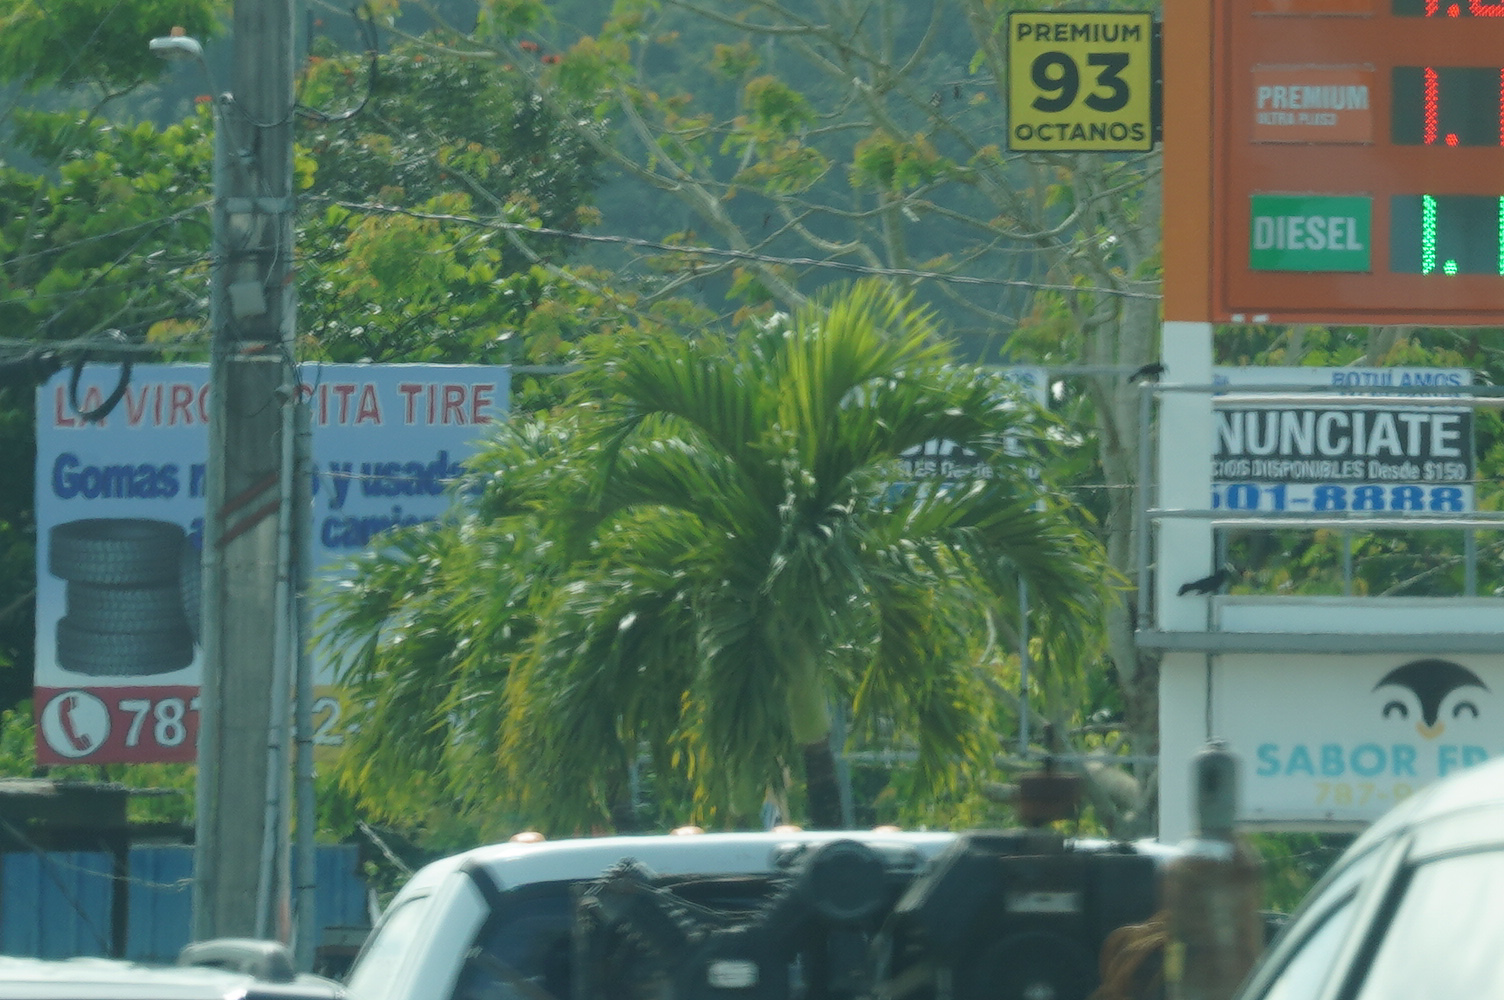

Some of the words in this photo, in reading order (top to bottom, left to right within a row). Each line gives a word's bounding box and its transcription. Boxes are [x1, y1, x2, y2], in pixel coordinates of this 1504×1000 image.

[1016, 23, 1141, 42] PREMIUM
[1030, 51, 1130, 113] 93
[1257, 85, 1369, 110] PREMIUM
[1015, 122, 1145, 142] OCTANOS
[1253, 216, 1363, 251] DIESEL
[55, 384, 108, 428] LA
[398, 383, 495, 426] TIRE
[1213, 410, 1462, 459] NUNCIATE
[53, 452, 181, 500] Gomas
[327, 460, 354, 511] y
[1252, 459, 1366, 480] DISPONIBLES
[1368, 459, 1421, 482] Desde
[1423, 461, 1468, 483] $150
[1213, 483, 1464, 512] 01-8888
[1256, 742, 1418, 778] SABOR
